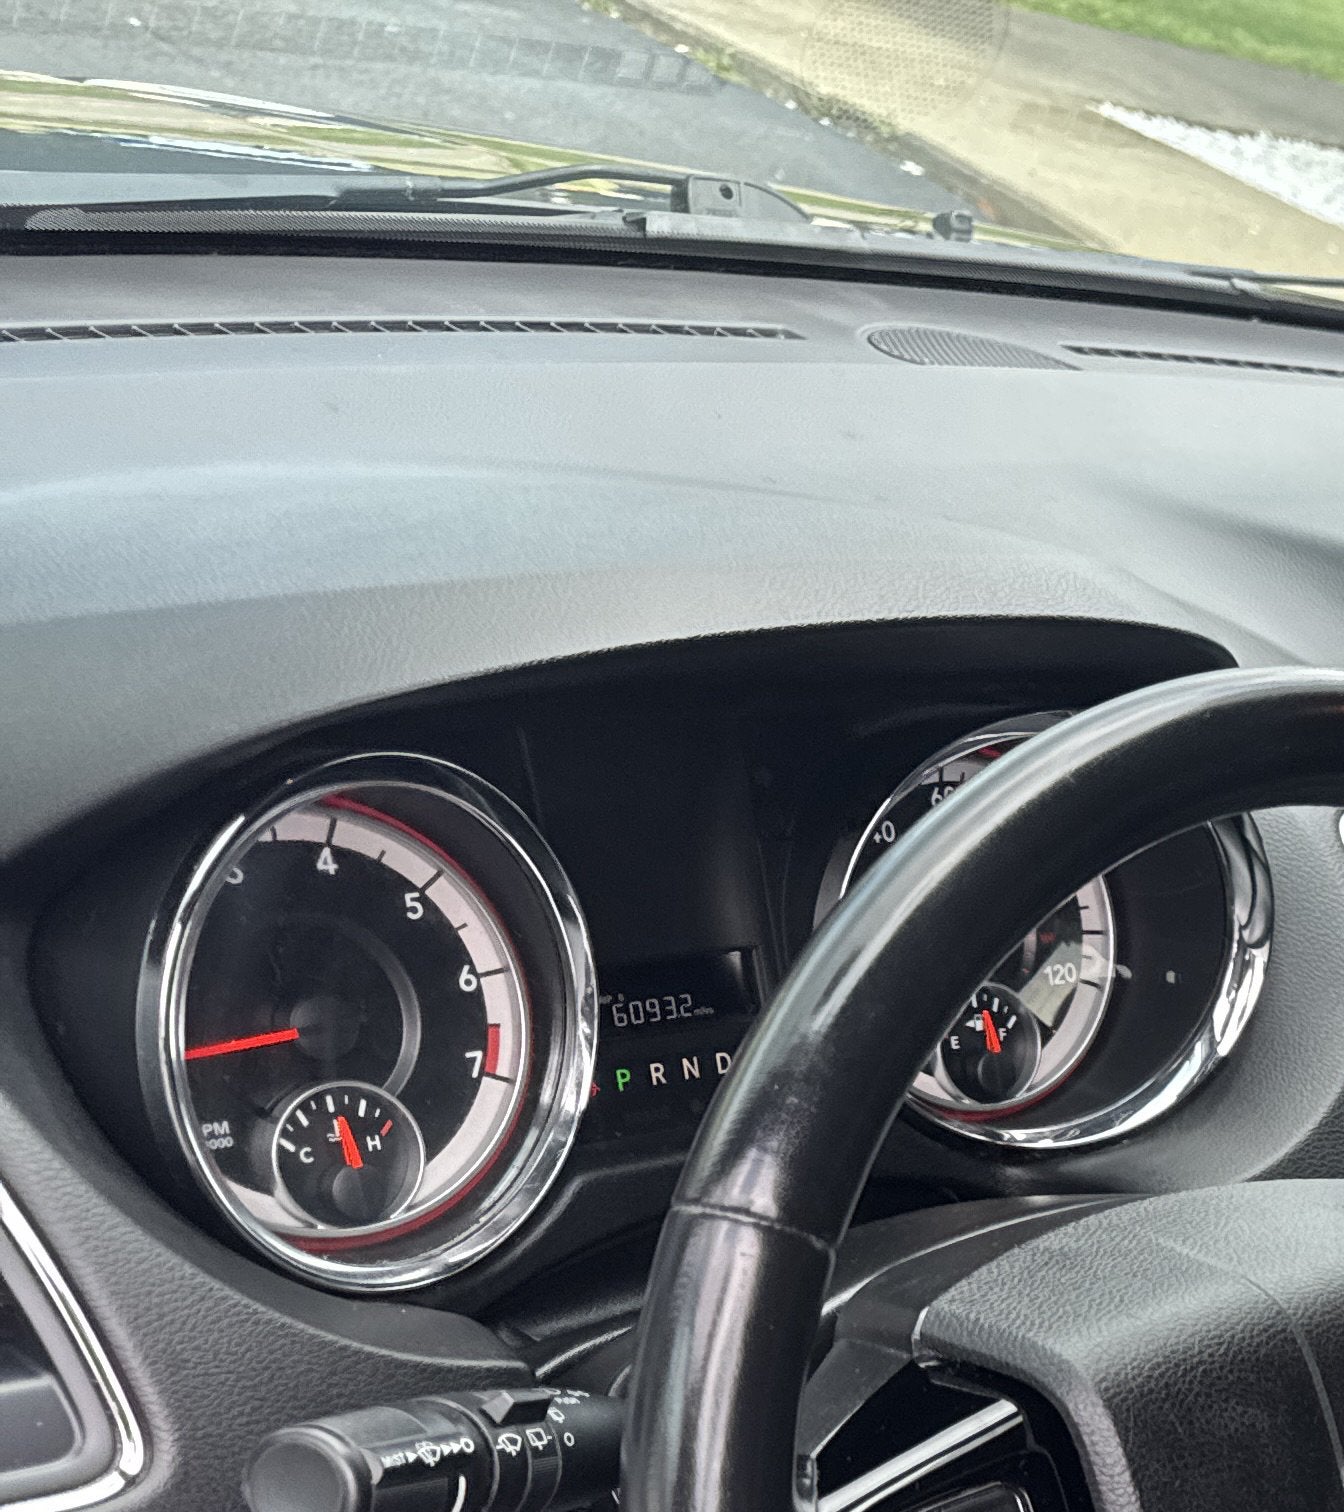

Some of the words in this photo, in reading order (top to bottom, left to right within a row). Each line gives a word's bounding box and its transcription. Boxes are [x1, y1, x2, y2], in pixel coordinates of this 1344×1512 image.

[316, 848, 338, 875] 4
[405, 893, 424, 920] 5
[458, 965, 478, 992] 6
[1044, 963, 1077, 986] 120
[612, 994, 692, 1027] 60932
[950, 1036, 960, 1050] E
[999, 1027, 1008, 1041] F
[464, 1050, 483, 1078] 7
[616, 1068, 631, 1092] P
[650, 1063, 667, 1086] R
[682, 1056, 700, 1080] N
[716, 1052, 732, 1075] D
[300, 1147, 314, 1163] C
[366, 1135, 381, 1151] H
